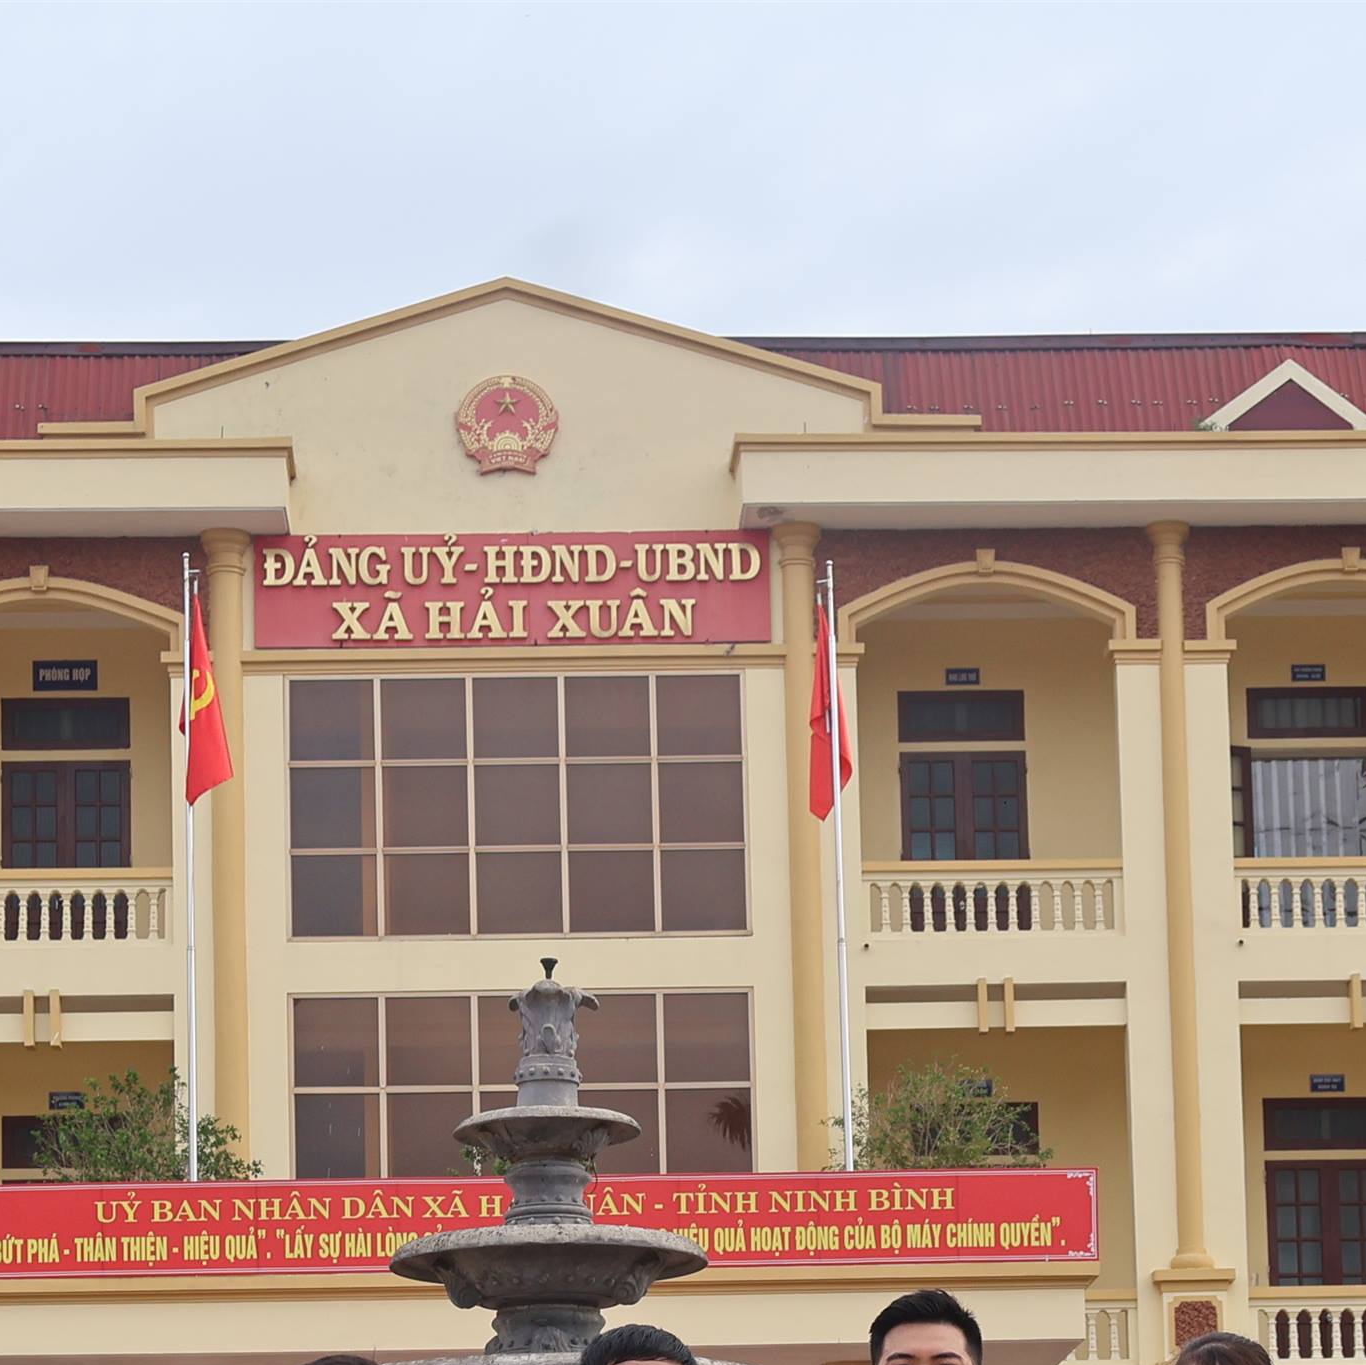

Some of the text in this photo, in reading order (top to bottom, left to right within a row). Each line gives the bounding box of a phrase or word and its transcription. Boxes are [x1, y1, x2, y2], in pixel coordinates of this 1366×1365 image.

[262, 534, 392, 587] ĐẢNG
[331, 586, 697, 641] XÃ HẢI XUÂN
[38, 665, 92, 684] PHÒNG HỌP
[94, 1191, 142, 1224] UỶ
[151, 1199, 223, 1223] BAN
[231, 1190, 333, 1221] NHÂN
[341, 1189, 415, 1219] DÂN
[421, 1189, 470, 1219] XÃ
[672, 1183, 760, 1215] TỈNH
[768, 1189, 858, 1213] NINH
[867, 1182, 956, 1212] BÌNH
[26, 1232, 60, 1264] PHÁ
[63, 1248, 70, 1256] -
[74, 1231, 117, 1263] THÂN
[121, 1230, 168, 1267] THIỆN
[172, 1246, 179, 1254] -
[183, 1229, 221, 1266] HIỆU
[318, 1230, 343, 1265] SỰ
[345, 1226, 372, 1258] HÀI
[713, 1218, 747, 1256] QUẢ
[750, 1226, 792, 1257] HOẠT
[795, 1220, 840, 1257] ĐỘNG
[843, 1216, 877, 1251] CỦA
[880, 1218, 903, 1255] BỘ
[906, 1217, 942, 1249] MÁY
[946, 1217, 996, 1249] CHÍNH
